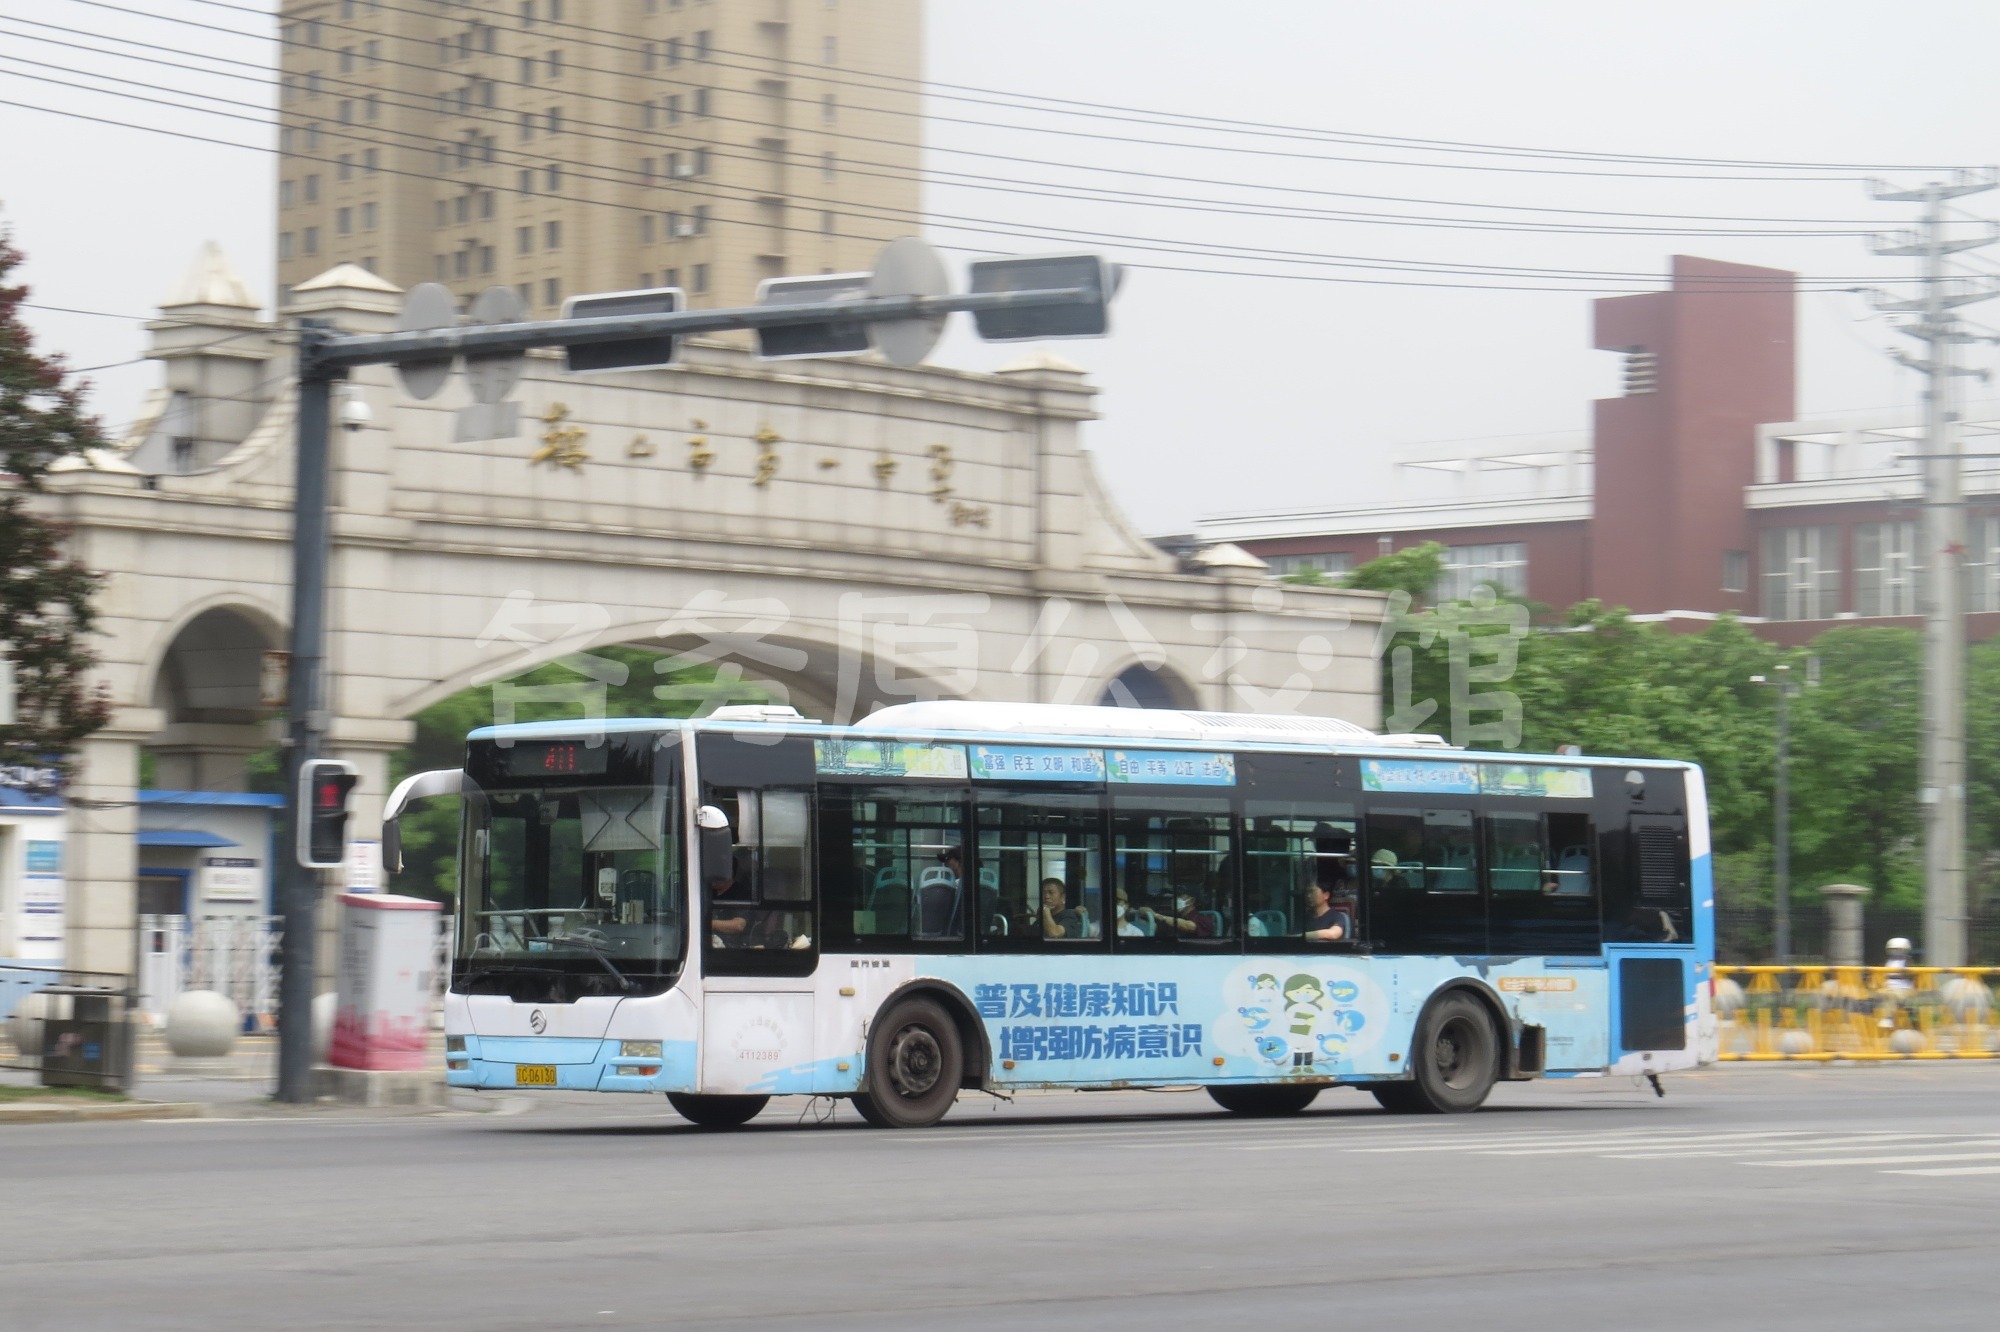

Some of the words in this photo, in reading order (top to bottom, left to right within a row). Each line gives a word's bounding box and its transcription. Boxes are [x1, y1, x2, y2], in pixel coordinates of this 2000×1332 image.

[984, 754, 1006, 771] 富强
[1013, 755, 1035, 772] 民主
[1042, 756, 1064, 773] 文明
[1071, 756, 1095, 774] 和谐
[1120, 759, 1140, 774] 自由
[1146, 760, 1167, 776] 平等
[1174, 760, 1195, 777] 公正
[1201, 761, 1222, 777] 法治
[975, 982, 1178, 1018] 普及健康知识
[999, 1023, 1203, 1061] 增强防病意识
[739, 1051, 779, 1061] 4112389
